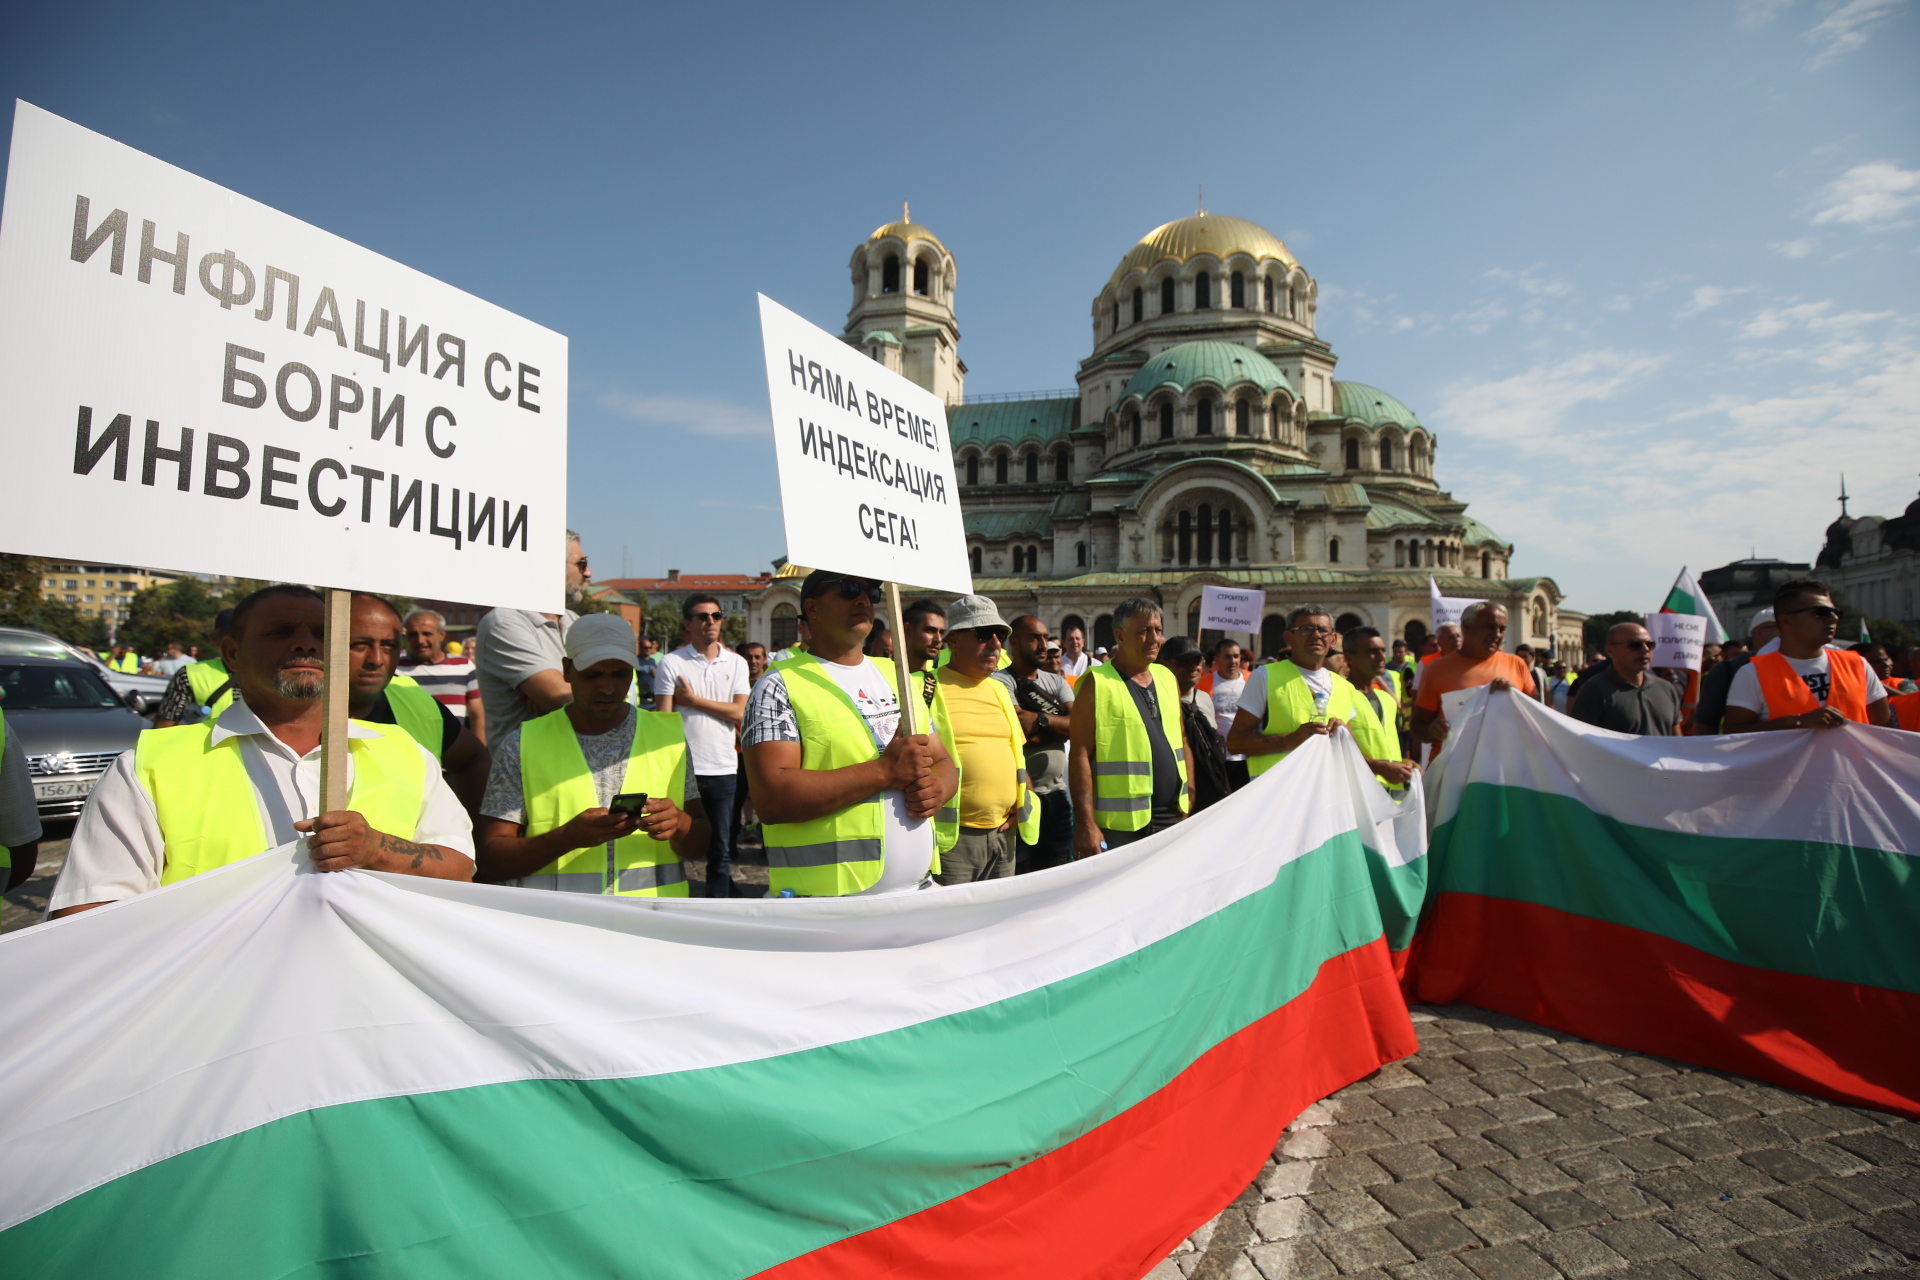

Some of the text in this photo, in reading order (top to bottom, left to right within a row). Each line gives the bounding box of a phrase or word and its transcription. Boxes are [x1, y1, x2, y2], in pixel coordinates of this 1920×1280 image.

[70, 194, 540, 414] ИНФЛАЦИЯ СЕ
[222, 342, 457, 459] БОРИ С
[788, 349, 940, 452] НЯМА ВРЕМЕ!
[73, 405, 528, 552] ИНВЕСТИЦИИ
[799, 418, 946, 504] ИНДЕКСАЦИЯ
[858, 503, 919, 550] СЕГА!
[1217, 593, 1249, 602] СТРОИТЕЛ
[41, 784, 74, 797] 1567
